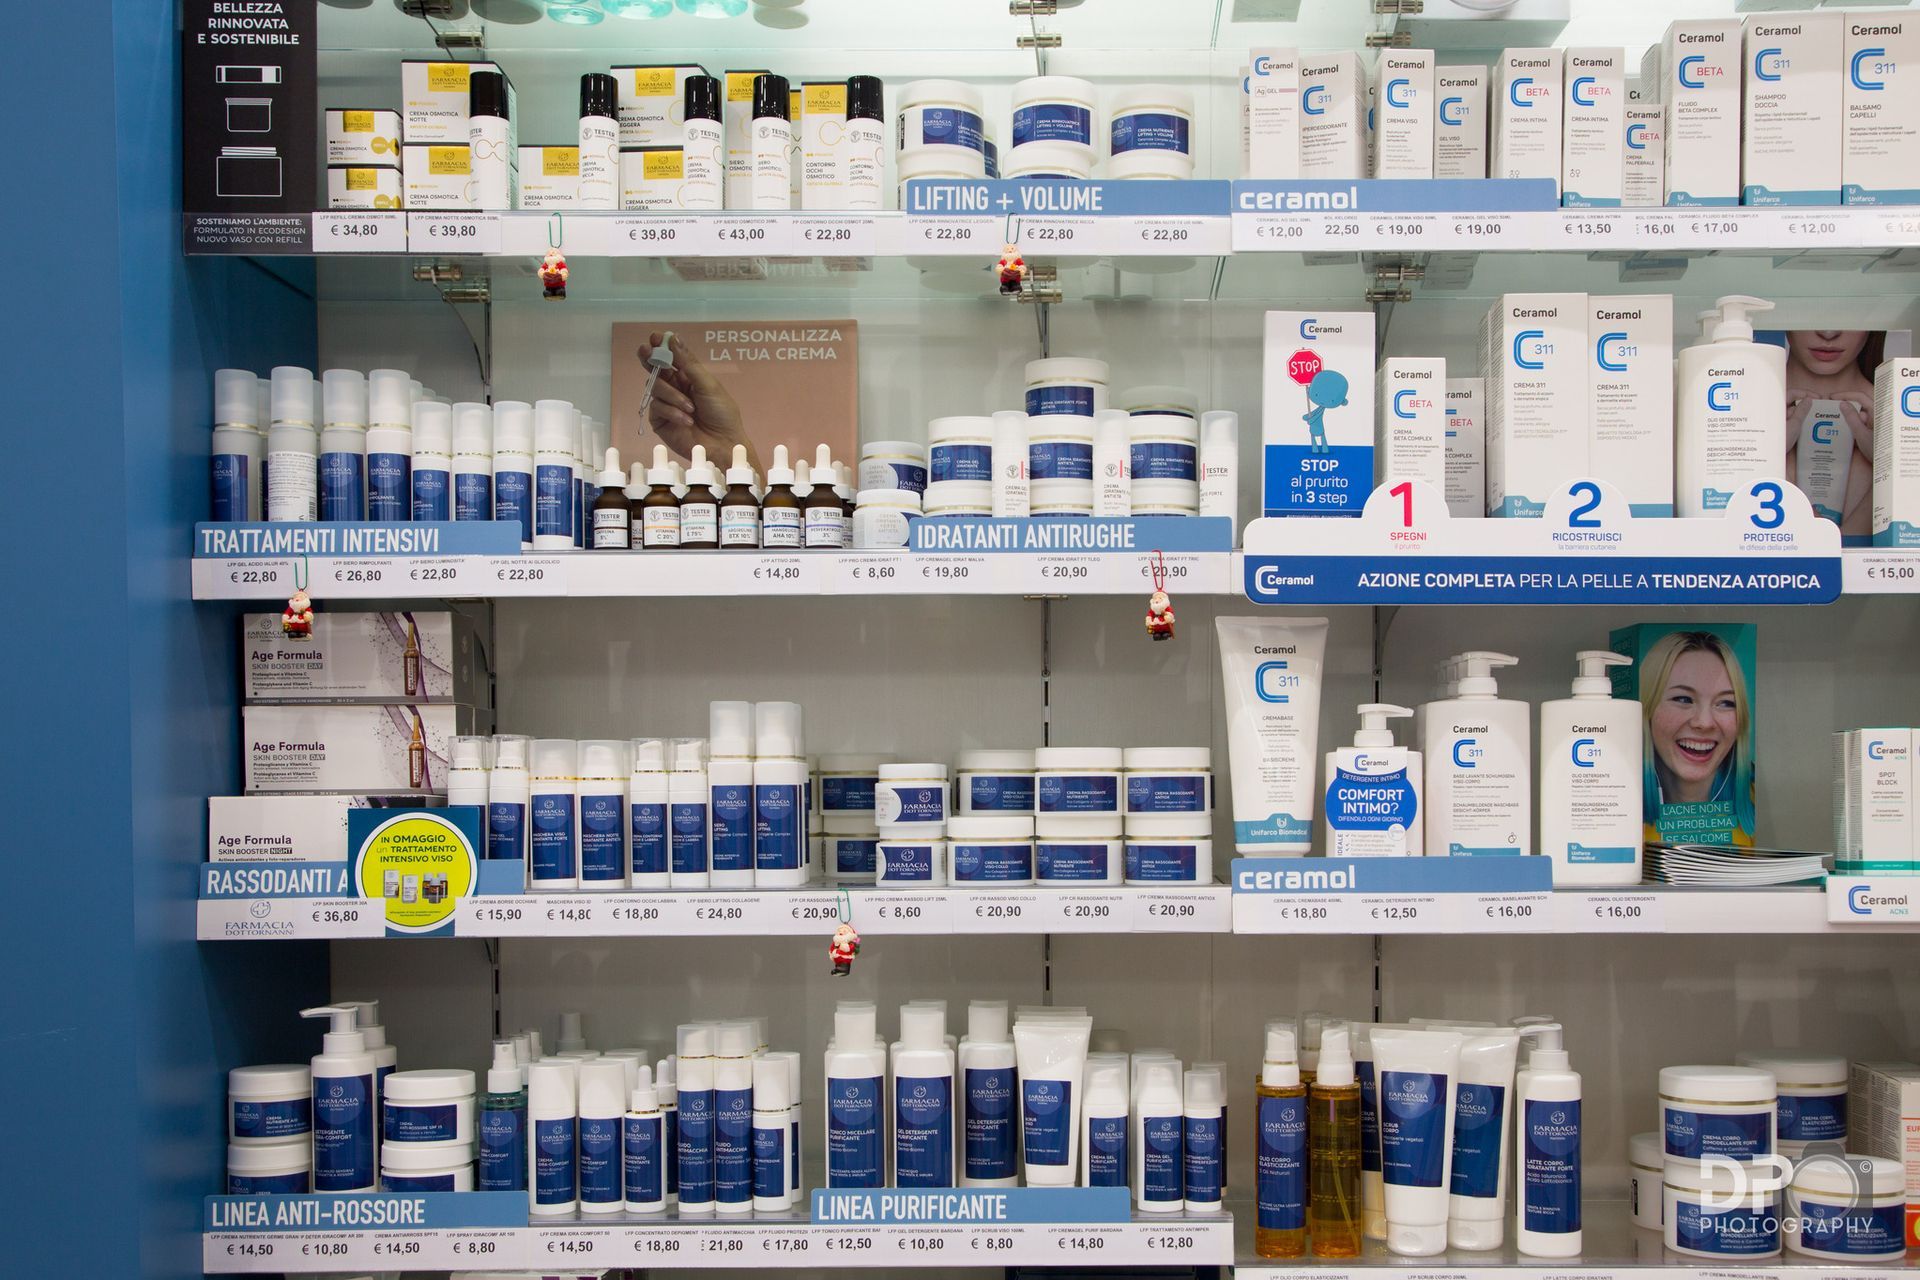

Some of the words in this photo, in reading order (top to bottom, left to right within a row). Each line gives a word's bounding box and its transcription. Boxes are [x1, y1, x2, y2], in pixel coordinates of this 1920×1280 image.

[213, 2, 283, 15] BELLEZZA
[208, 18, 289, 30] RINNOVATA
[1754, 25, 1802, 37] Ceramol
[1851, 24, 1902, 37] Ceramol
[197, 34, 206, 45] E
[210, 33, 300, 46] SOSTENIBILE
[1678, 32, 1725, 44] Ceramol
[1387, 59, 1425, 70] Ceramol
[1773, 59, 1791, 69] 311
[1874, 62, 1896, 74] 311
[1696, 66, 1724, 77] BETA
[1402, 88, 1417, 98] 311
[1849, 103, 1882, 111] BALSAMO
[913, 186, 989, 211] LIFTING
[996, 192, 1014, 210] +
[1020, 186, 1103, 211] VOLUME
[1239, 186, 1358, 210] ceramol
[196, 218, 252, 226] SOSTENIAMO
[252, 217, 302, 226] L'AMBIENTE:
[193, 227, 243, 235] FORMULATO
[258, 227, 306, 235] ECODESIGN
[330, 225, 339, 236] €
[342, 225, 378, 237] 34,80
[1691, 222, 1699, 234] €
[1703, 222, 1738, 235] 17,00
[196, 236, 227, 244] NUOVO
[229, 236, 253, 244] VASO
[254, 236, 274, 244] CON
[276, 236, 303, 244] REFILL
[718, 229, 726, 241] €
[730, 229, 765, 241] 43,00
[1512, 307, 1558, 319] Ceramol
[705, 329, 842, 343] PERSONALIZZA
[1308, 325, 1343, 335] Ceramol
[710, 349, 732, 361] LA
[736, 349, 770, 361] TUA
[775, 347, 837, 360] CREMA
[1534, 344, 1554, 355] 311
[1290, 359, 1321, 377] STOP
[1708, 368, 1745, 378] Ceramol
[1301, 460, 1339, 472] STOP
[1290, 475, 1302, 488] al
[1305, 475, 1349, 491] prurito
[1291, 491, 1303, 504] in
[1305, 491, 1316, 504] 3
[1318, 491, 1348, 507] step
[1389, 482, 1413, 528] 1
[1568, 481, 1603, 529] 2
[1750, 481, 1785, 530] 3
[201, 528, 336, 554] TRATTAMENTI
[343, 528, 439, 553] INTENSIVI
[917, 524, 1018, 550] IDRATANTI
[1024, 523, 1135, 549] ANTIRUGHE
[1389, 532, 1427, 542] SPEGNI
[1553, 532, 1622, 542] RICOSTRUISCI
[1743, 533, 1794, 542] PROTEGGI
[753, 568, 761, 579] €
[765, 567, 800, 580] 14,80
[1867, 567, 1876, 579] €
[1879, 567, 1915, 579] 15,00
[1266, 574, 1314, 586] Ceramol
[1357, 573, 1421, 588] AZIONE
[1424, 573, 1515, 588] COMPLETA
[1520, 574, 1554, 588] PER
[1557, 574, 1578, 588] LA
[1582, 574, 1633, 589] PELLE
[1637, 574, 1648, 589] A
[1652, 574, 1744, 589] TENDENZA
[1746, 574, 1821, 589] ATOPICA
[1254, 644, 1297, 655] Ceramol
[251, 650, 274, 663] Age
[276, 650, 323, 661] Formula
[1278, 675, 1300, 688] 311
[1572, 724, 1607, 734] Ceramol
[1361, 759, 1389, 767] Ceramol
[1337, 788, 1405, 801] COMFORT
[1342, 801, 1399, 815] INTIMO?
[1662, 804, 1695, 816] L'ACNE
[1698, 804, 1720, 815] NON
[1659, 819, 1675, 831] UN
[1678, 818, 1736, 831] PROBLEMA,
[218, 835, 241, 848] Age
[243, 835, 292, 846] Formula
[380, 835, 391, 844] IN
[392, 834, 446, 844] OMAGGIO
[269, 847, 293, 855] NIGHT
[390, 845, 457, 854] TRATTAMENTO
[380, 855, 429, 864] INTENSIVO
[430, 855, 453, 863] VISO
[207, 870, 332, 894] RASSODANTI
[1239, 864, 1356, 890] ceramol
[1860, 894, 1908, 906] Ceramol
[312, 911, 320, 922] €
[324, 910, 359, 923] 36,80
[696, 908, 705, 920] €
[707, 908, 743, 920] 24,80
[1371, 908, 1379, 919] €
[1383, 906, 1418, 920] 12,50
[1595, 906, 1603, 918] €
[1607, 906, 1642, 919] 16,00
[225, 921, 294, 930] FARMACIA
[1388, 1092, 1429, 1100] FARMACIA
[212, 1200, 269, 1227] LINEA
[275, 1199, 425, 1226] ANTI-ROSSORE
[818, 1195, 875, 1221] LINEA
[881, 1194, 1007, 1221] PURIFICANTE
[227, 1244, 235, 1255] €
[239, 1243, 274, 1256] 14,50
[633, 1240, 642, 1252] €
[646, 1239, 680, 1252] 18,80
[898, 1238, 907, 1250] €
[909, 1237, 944, 1250] 10,80
